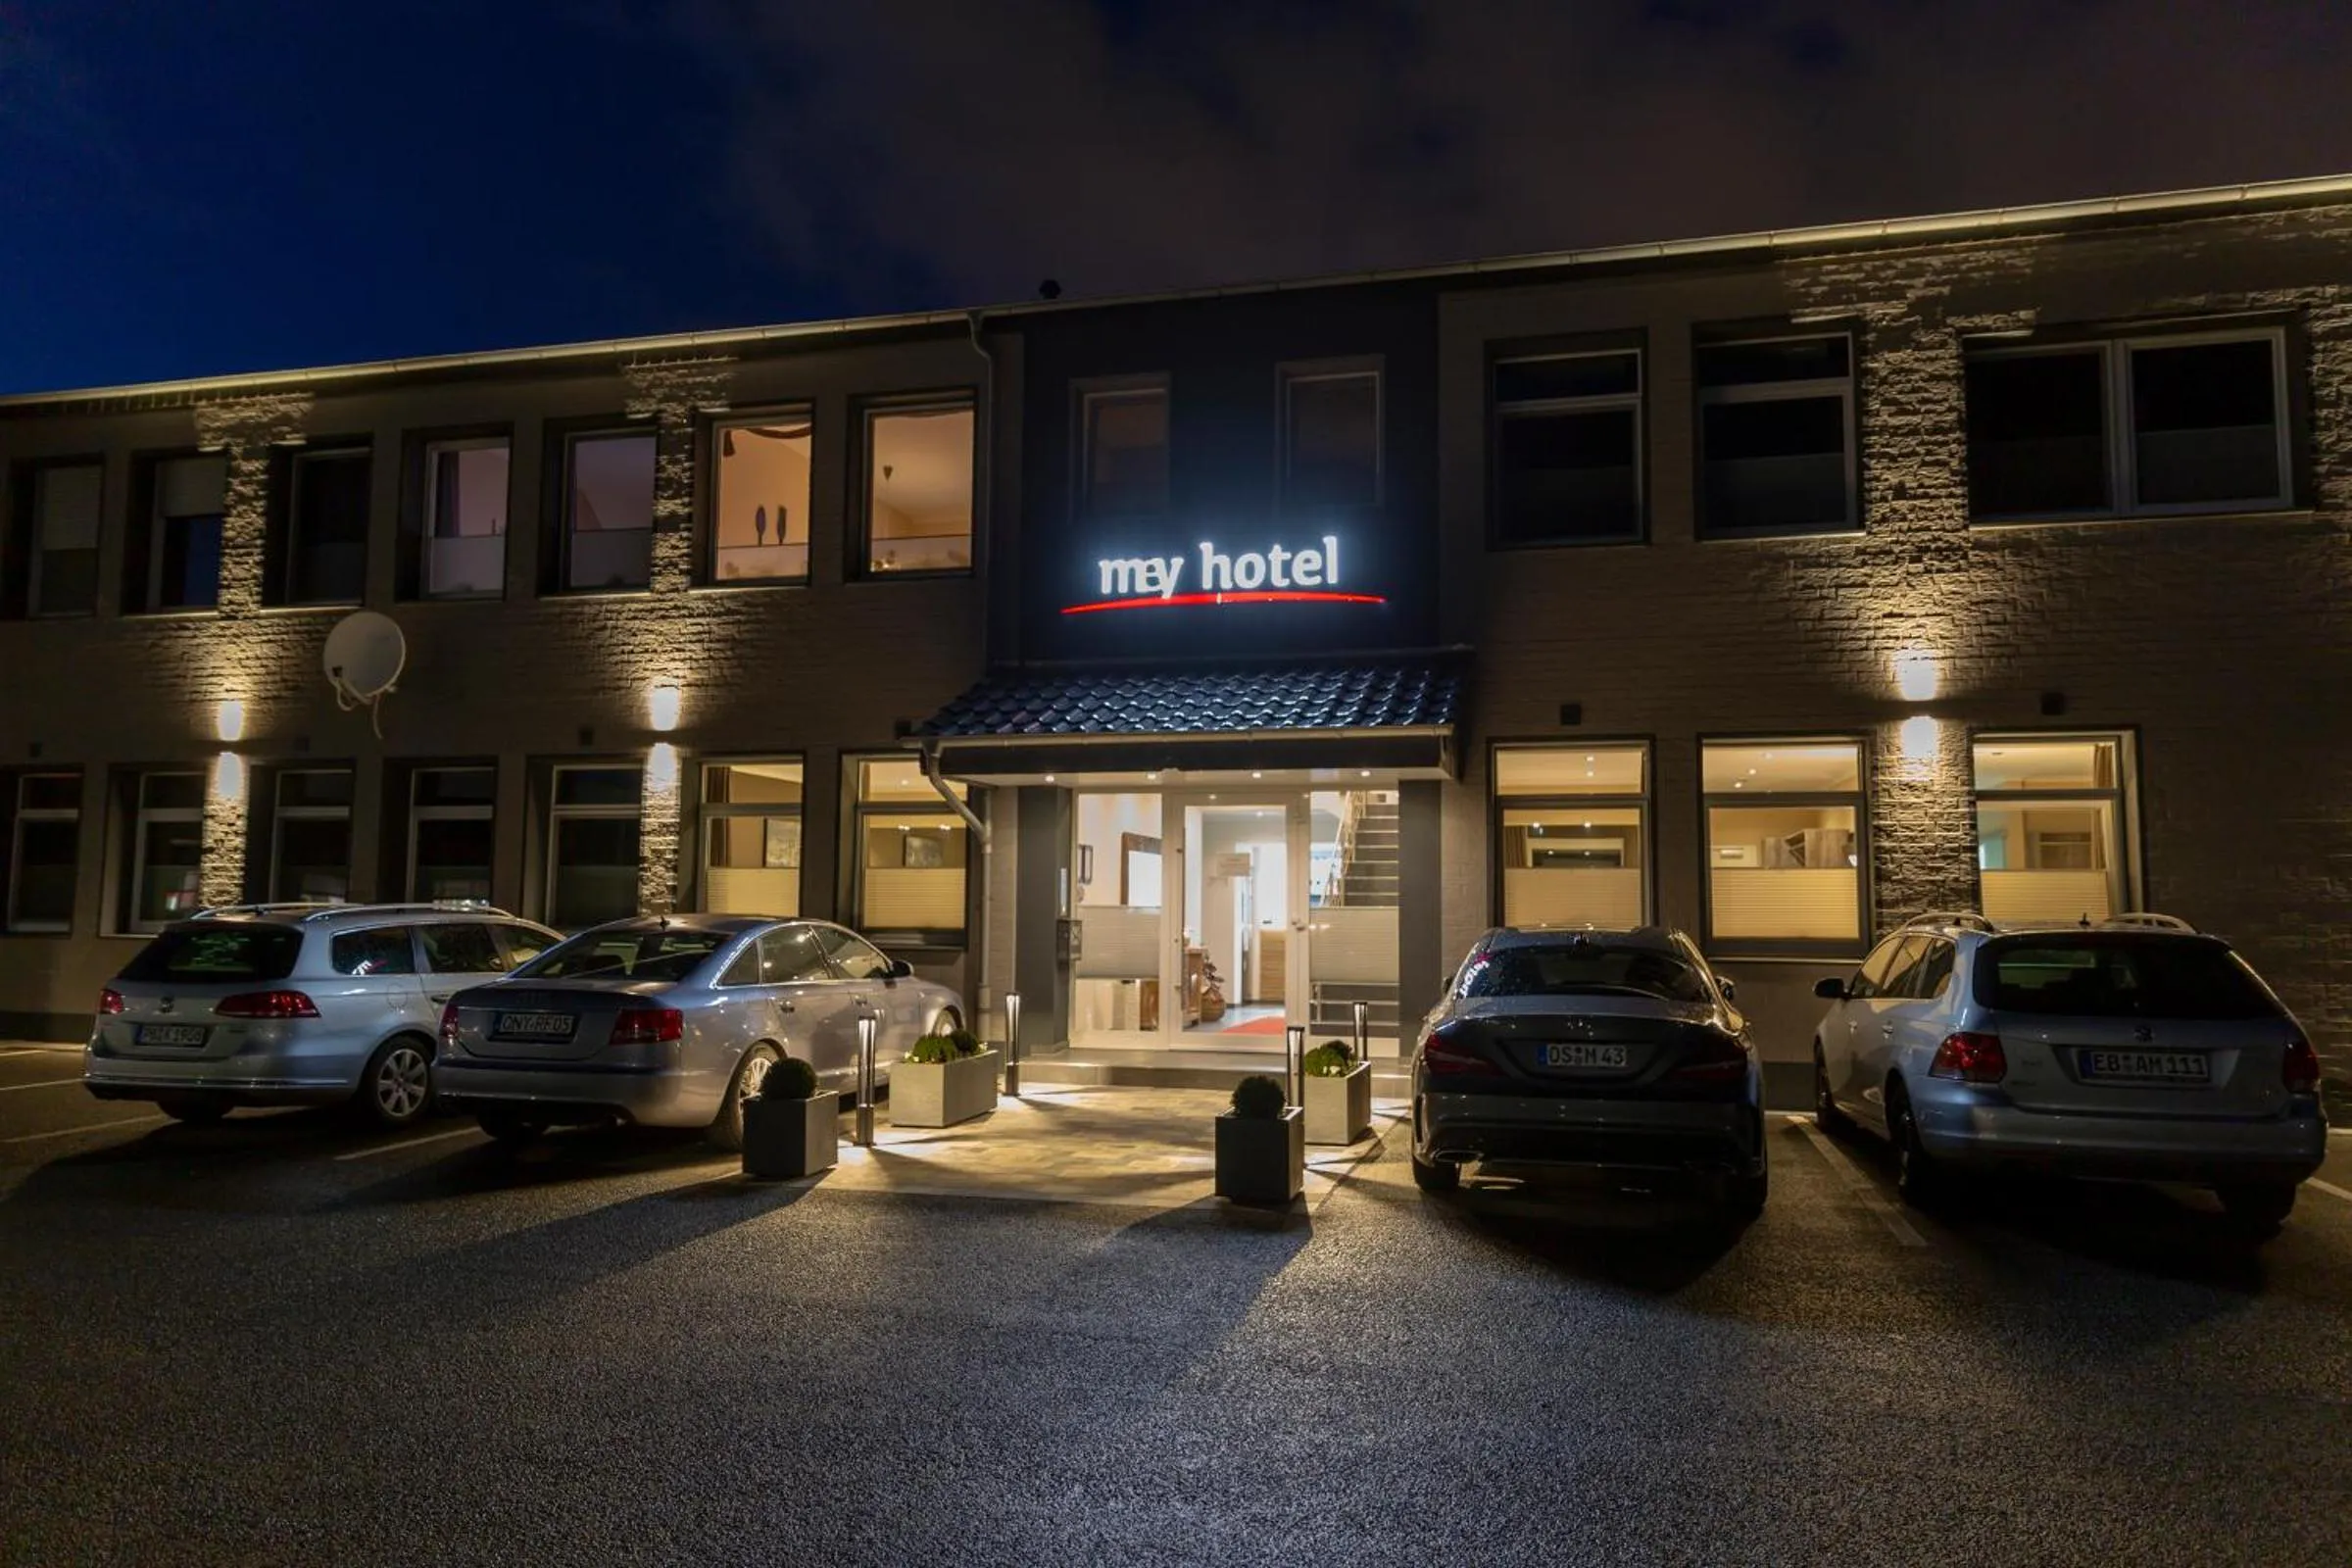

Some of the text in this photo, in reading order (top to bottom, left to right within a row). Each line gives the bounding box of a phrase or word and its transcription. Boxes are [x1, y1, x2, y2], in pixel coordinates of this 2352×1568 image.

[1200, 536, 1338, 590] hotel
[1548, 1046, 1572, 1063] OS
[2166, 1055, 2205, 1076] 111
